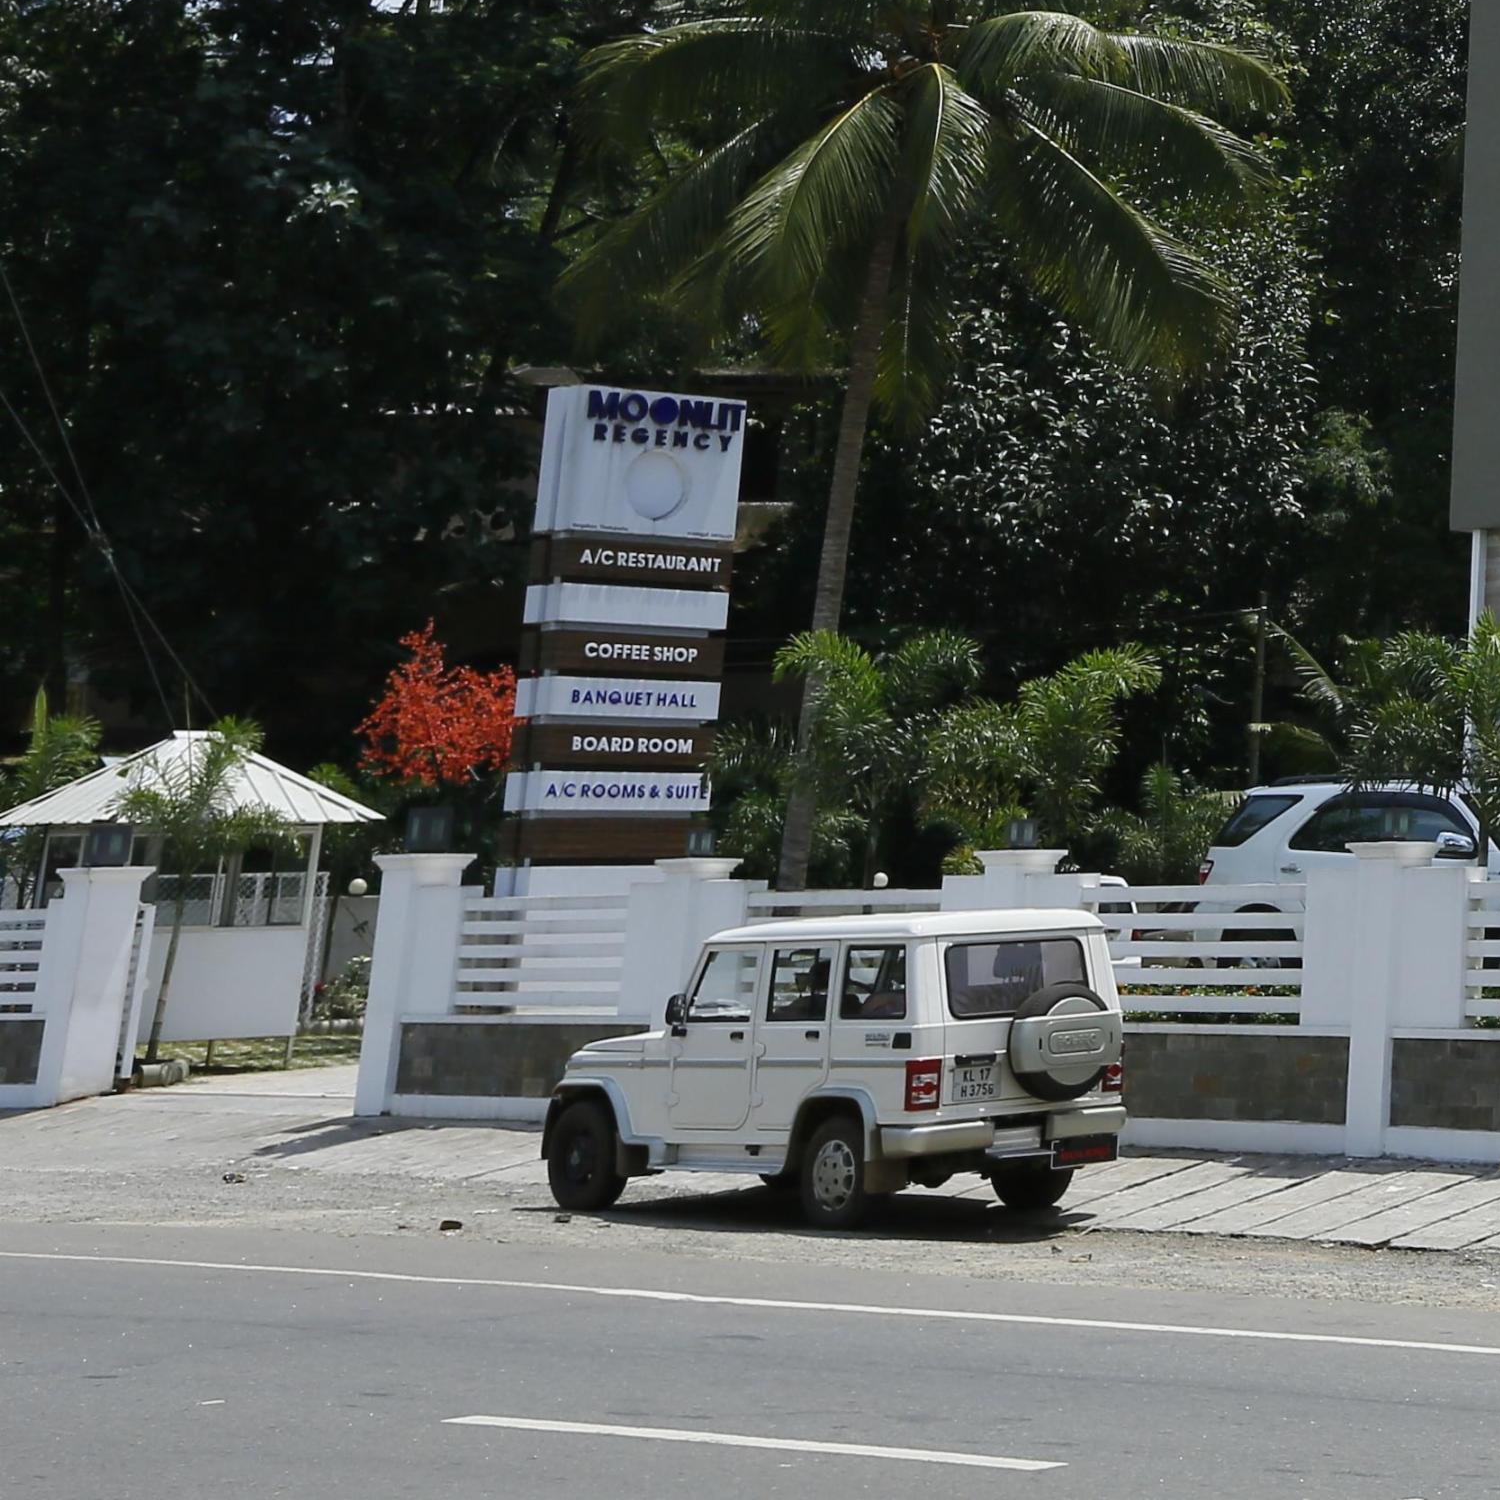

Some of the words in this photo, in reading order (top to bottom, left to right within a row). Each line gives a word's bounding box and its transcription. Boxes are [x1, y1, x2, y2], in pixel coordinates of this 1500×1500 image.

[587, 390, 746, 432] MOONLIT
[594, 423, 732, 452] REGENCY
[580, 548, 614, 565] A/C
[617, 552, 721, 573] RESTAURANT
[585, 642, 650, 660] COFFEE
[653, 646, 698, 662] SHOP
[571, 689, 653, 706] BANQUET
[656, 693, 697, 707] HALL
[572, 736, 634, 752] BOARD
[637, 738, 693, 754] ROOM
[546, 782, 577, 800] A/C
[580, 783, 646, 799] ROOMS
[649, 784, 660, 798] &
[963, 1069, 975, 1082] KL
[980, 1067, 991, 1080] 17
